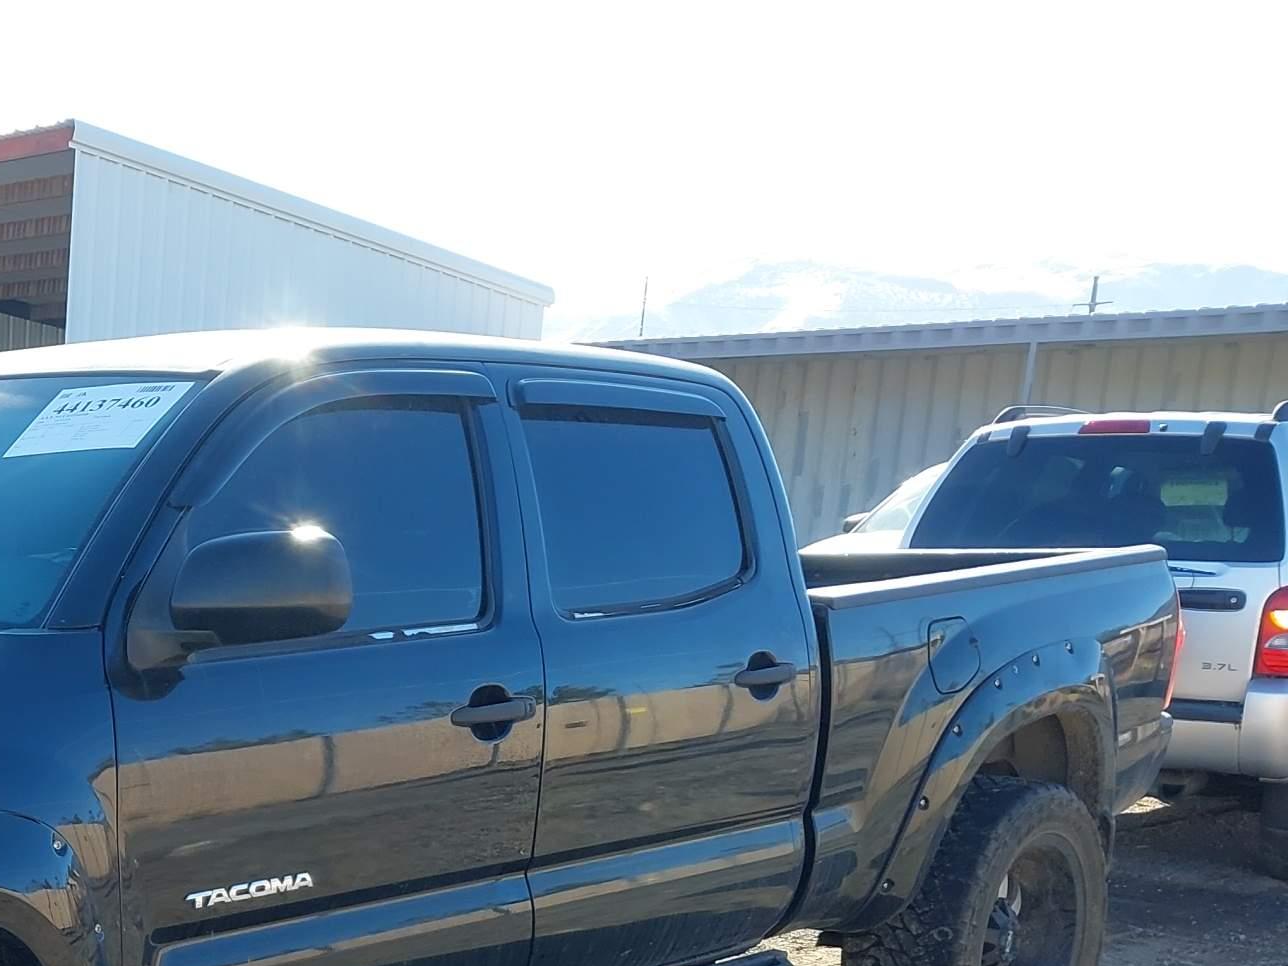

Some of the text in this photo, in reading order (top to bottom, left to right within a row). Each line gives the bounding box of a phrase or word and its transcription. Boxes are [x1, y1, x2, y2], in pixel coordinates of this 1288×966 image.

[53, 395, 161, 415] 44137460
[1201, 662, 1238, 671] 3.7L
[185, 872, 313, 909] TACOMA
